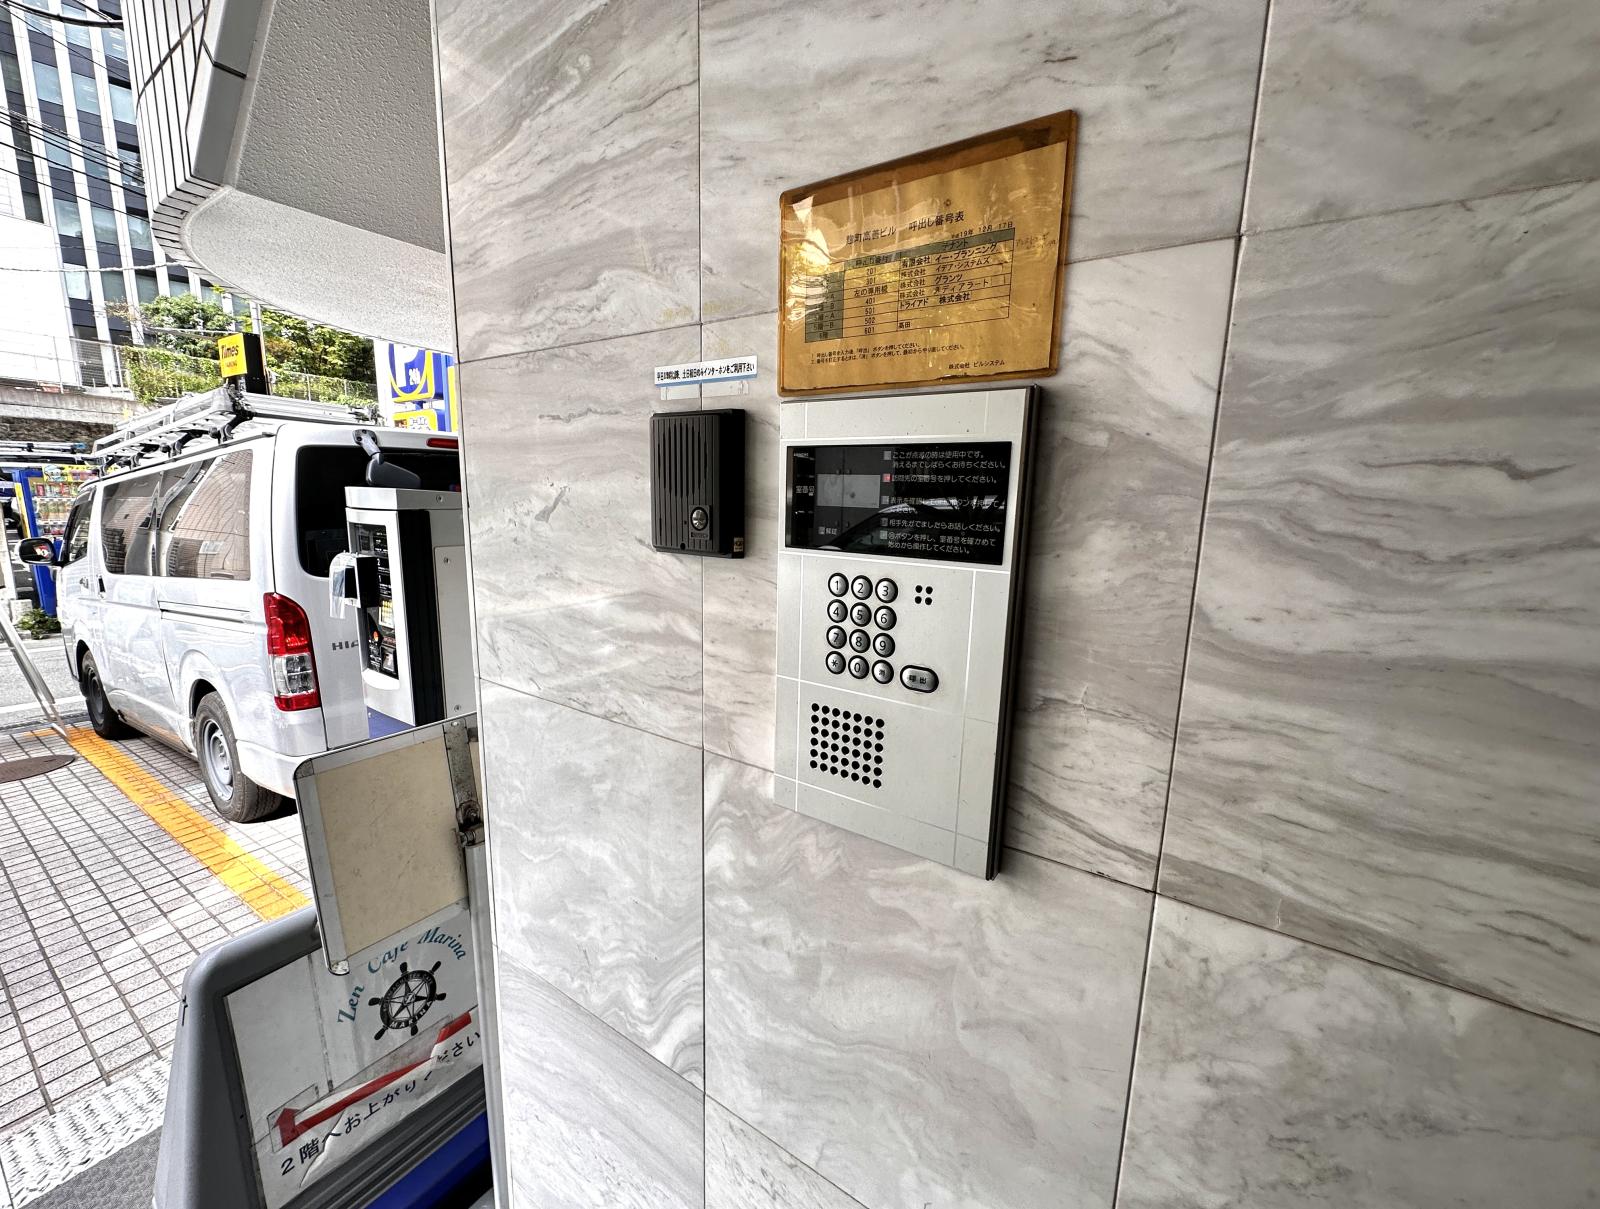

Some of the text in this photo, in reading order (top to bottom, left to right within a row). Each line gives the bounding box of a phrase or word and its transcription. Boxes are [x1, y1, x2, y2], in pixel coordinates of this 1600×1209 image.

[908, 210, 965, 231] 呼出し番号表
[900, 279, 925, 289] 株式会社
[900, 289, 925, 299] 株式会社
[939, 293, 970, 304] 株式会社
[865, 297, 876, 305] 401
[865, 307, 875, 315] 501
[337, 984, 365, 1023] Zen
[417, 926, 466, 960] Marina
